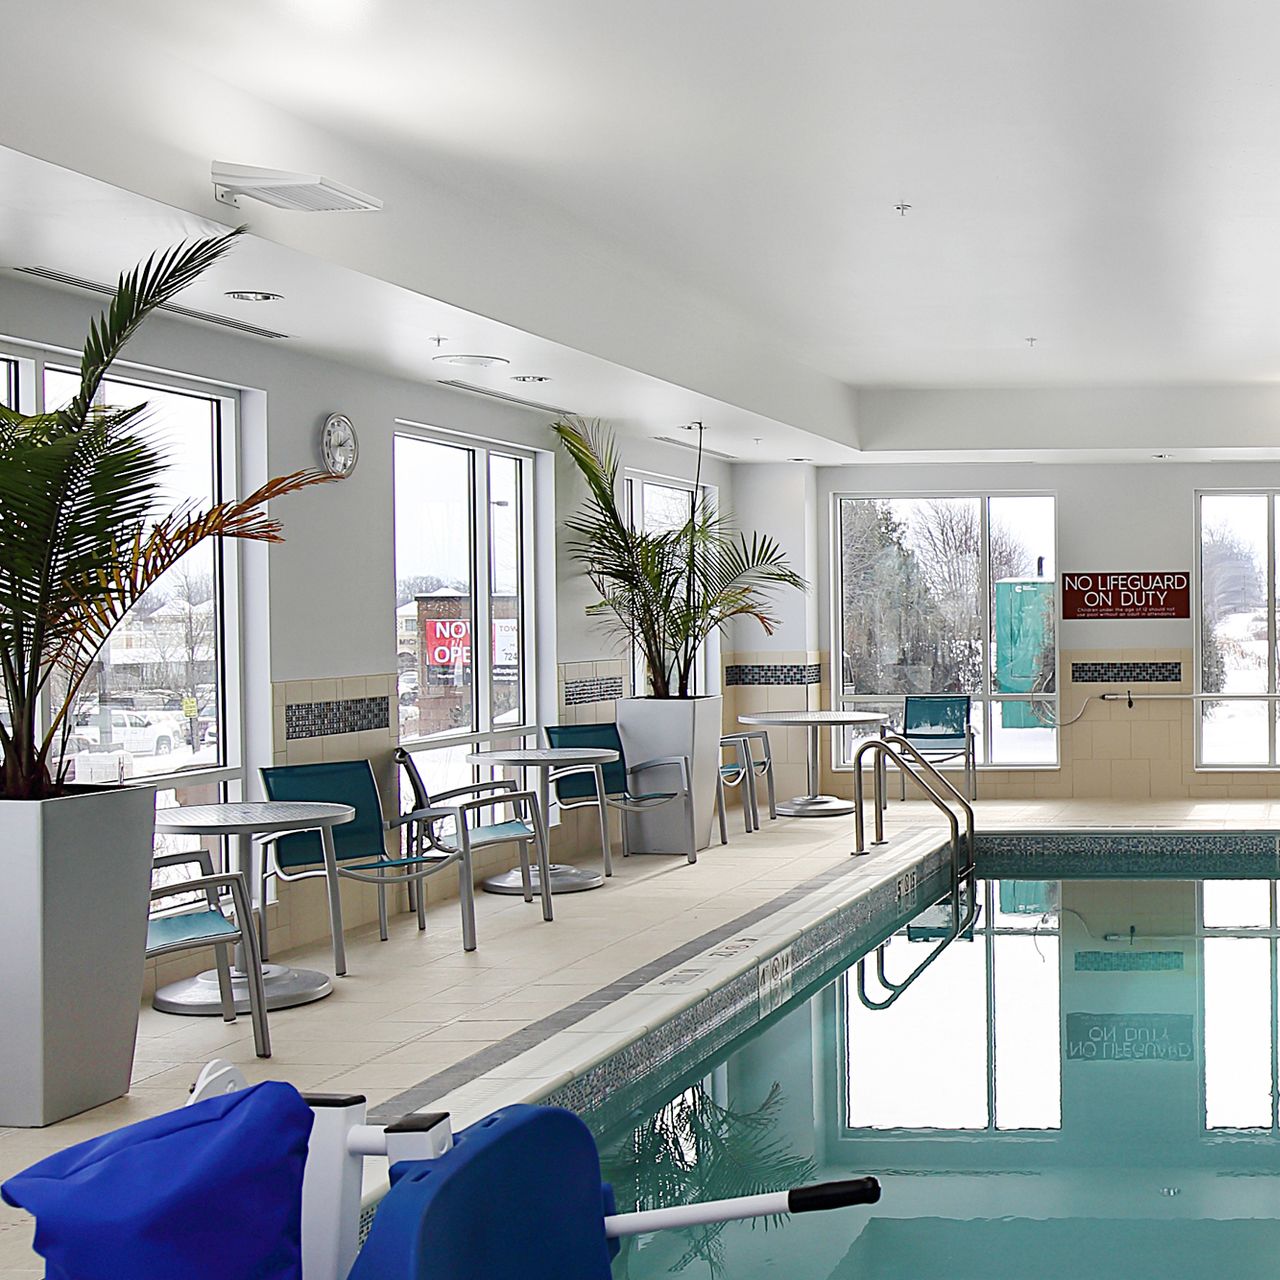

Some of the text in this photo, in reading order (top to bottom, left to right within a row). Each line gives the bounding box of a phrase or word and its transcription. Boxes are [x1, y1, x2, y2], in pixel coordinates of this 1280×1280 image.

[1065, 574, 1187, 591] NO LIFEGUARD
[1084, 591, 1168, 607] ON DUTY
[435, 621, 470, 639] NO
